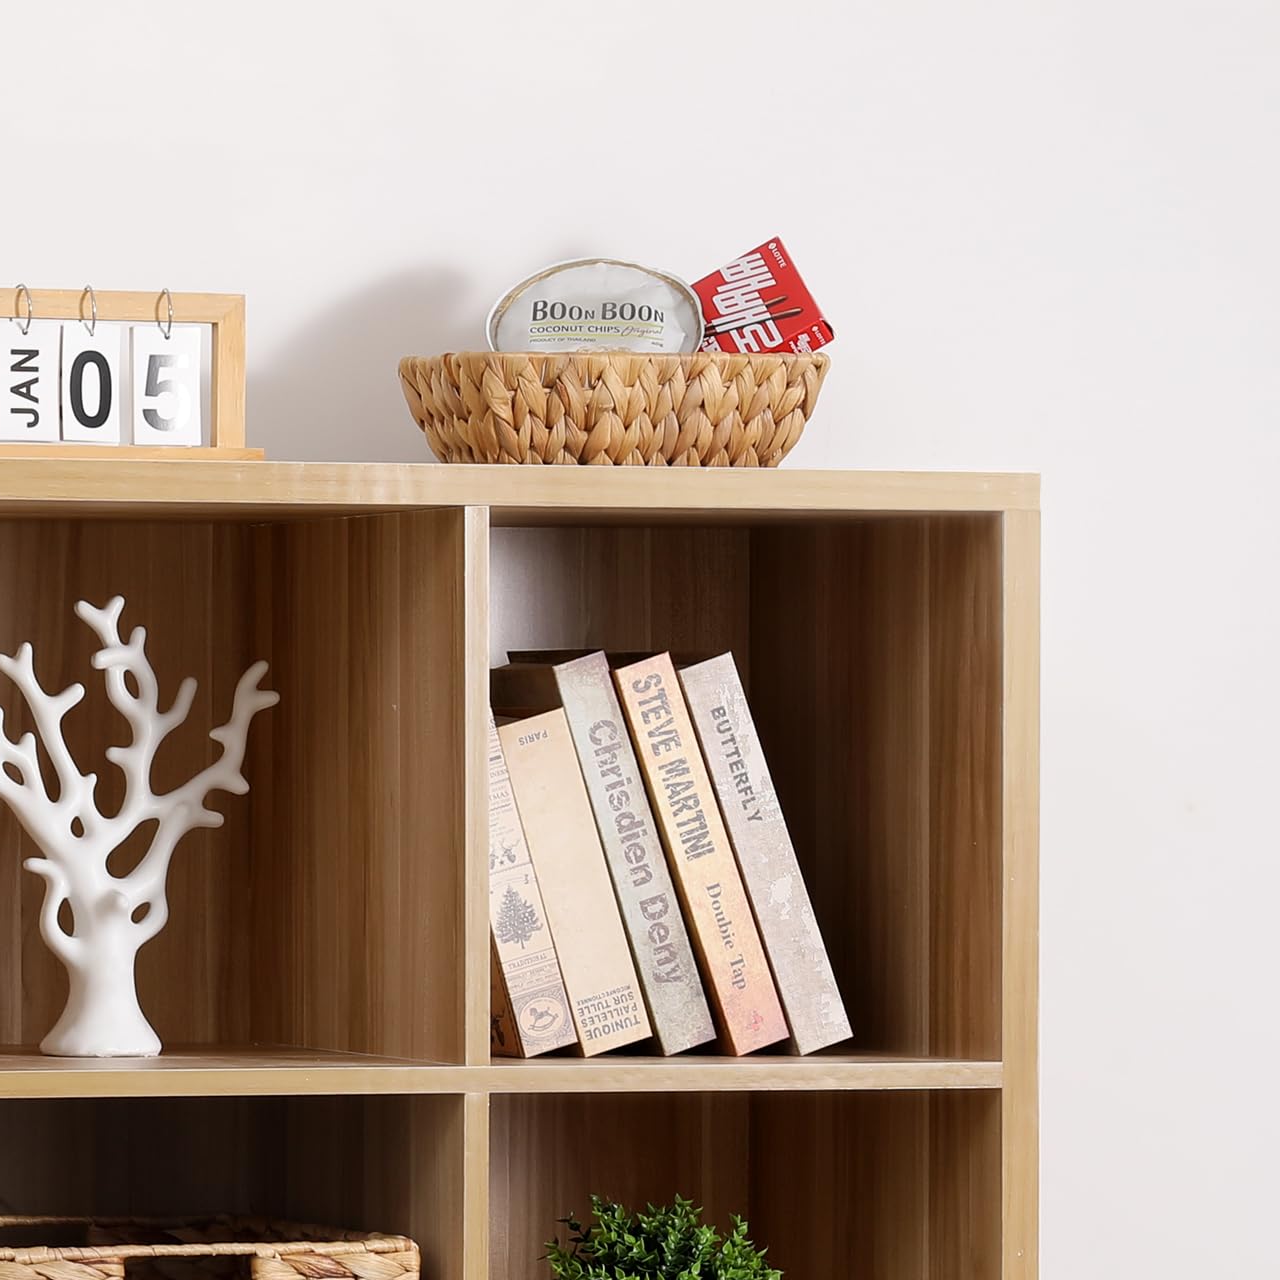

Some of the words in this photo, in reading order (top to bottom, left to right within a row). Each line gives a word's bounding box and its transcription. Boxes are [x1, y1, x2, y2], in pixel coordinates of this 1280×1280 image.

[772, 248, 787, 269] LOTTE
[530, 325, 583, 334] COCONUT
[587, 325, 620, 334] CHIPS
[621, 325, 664, 338] Original
[10, 349, 40, 428] JAN
[518, 729, 549, 746] PARIS
[632, 672, 682, 757] STEVE
[658, 756, 716, 862] MARTINI
[710, 705, 764, 825] BUTTERFLY
[588, 719, 656, 888] Chrisdien
[639, 892, 685, 985] Deny
[727, 953, 748, 991] Tap
[577, 999, 612, 1018] TULLE
[612, 991, 634, 1006] SUR
[584, 1014, 641, 1041] TUNIQUE
